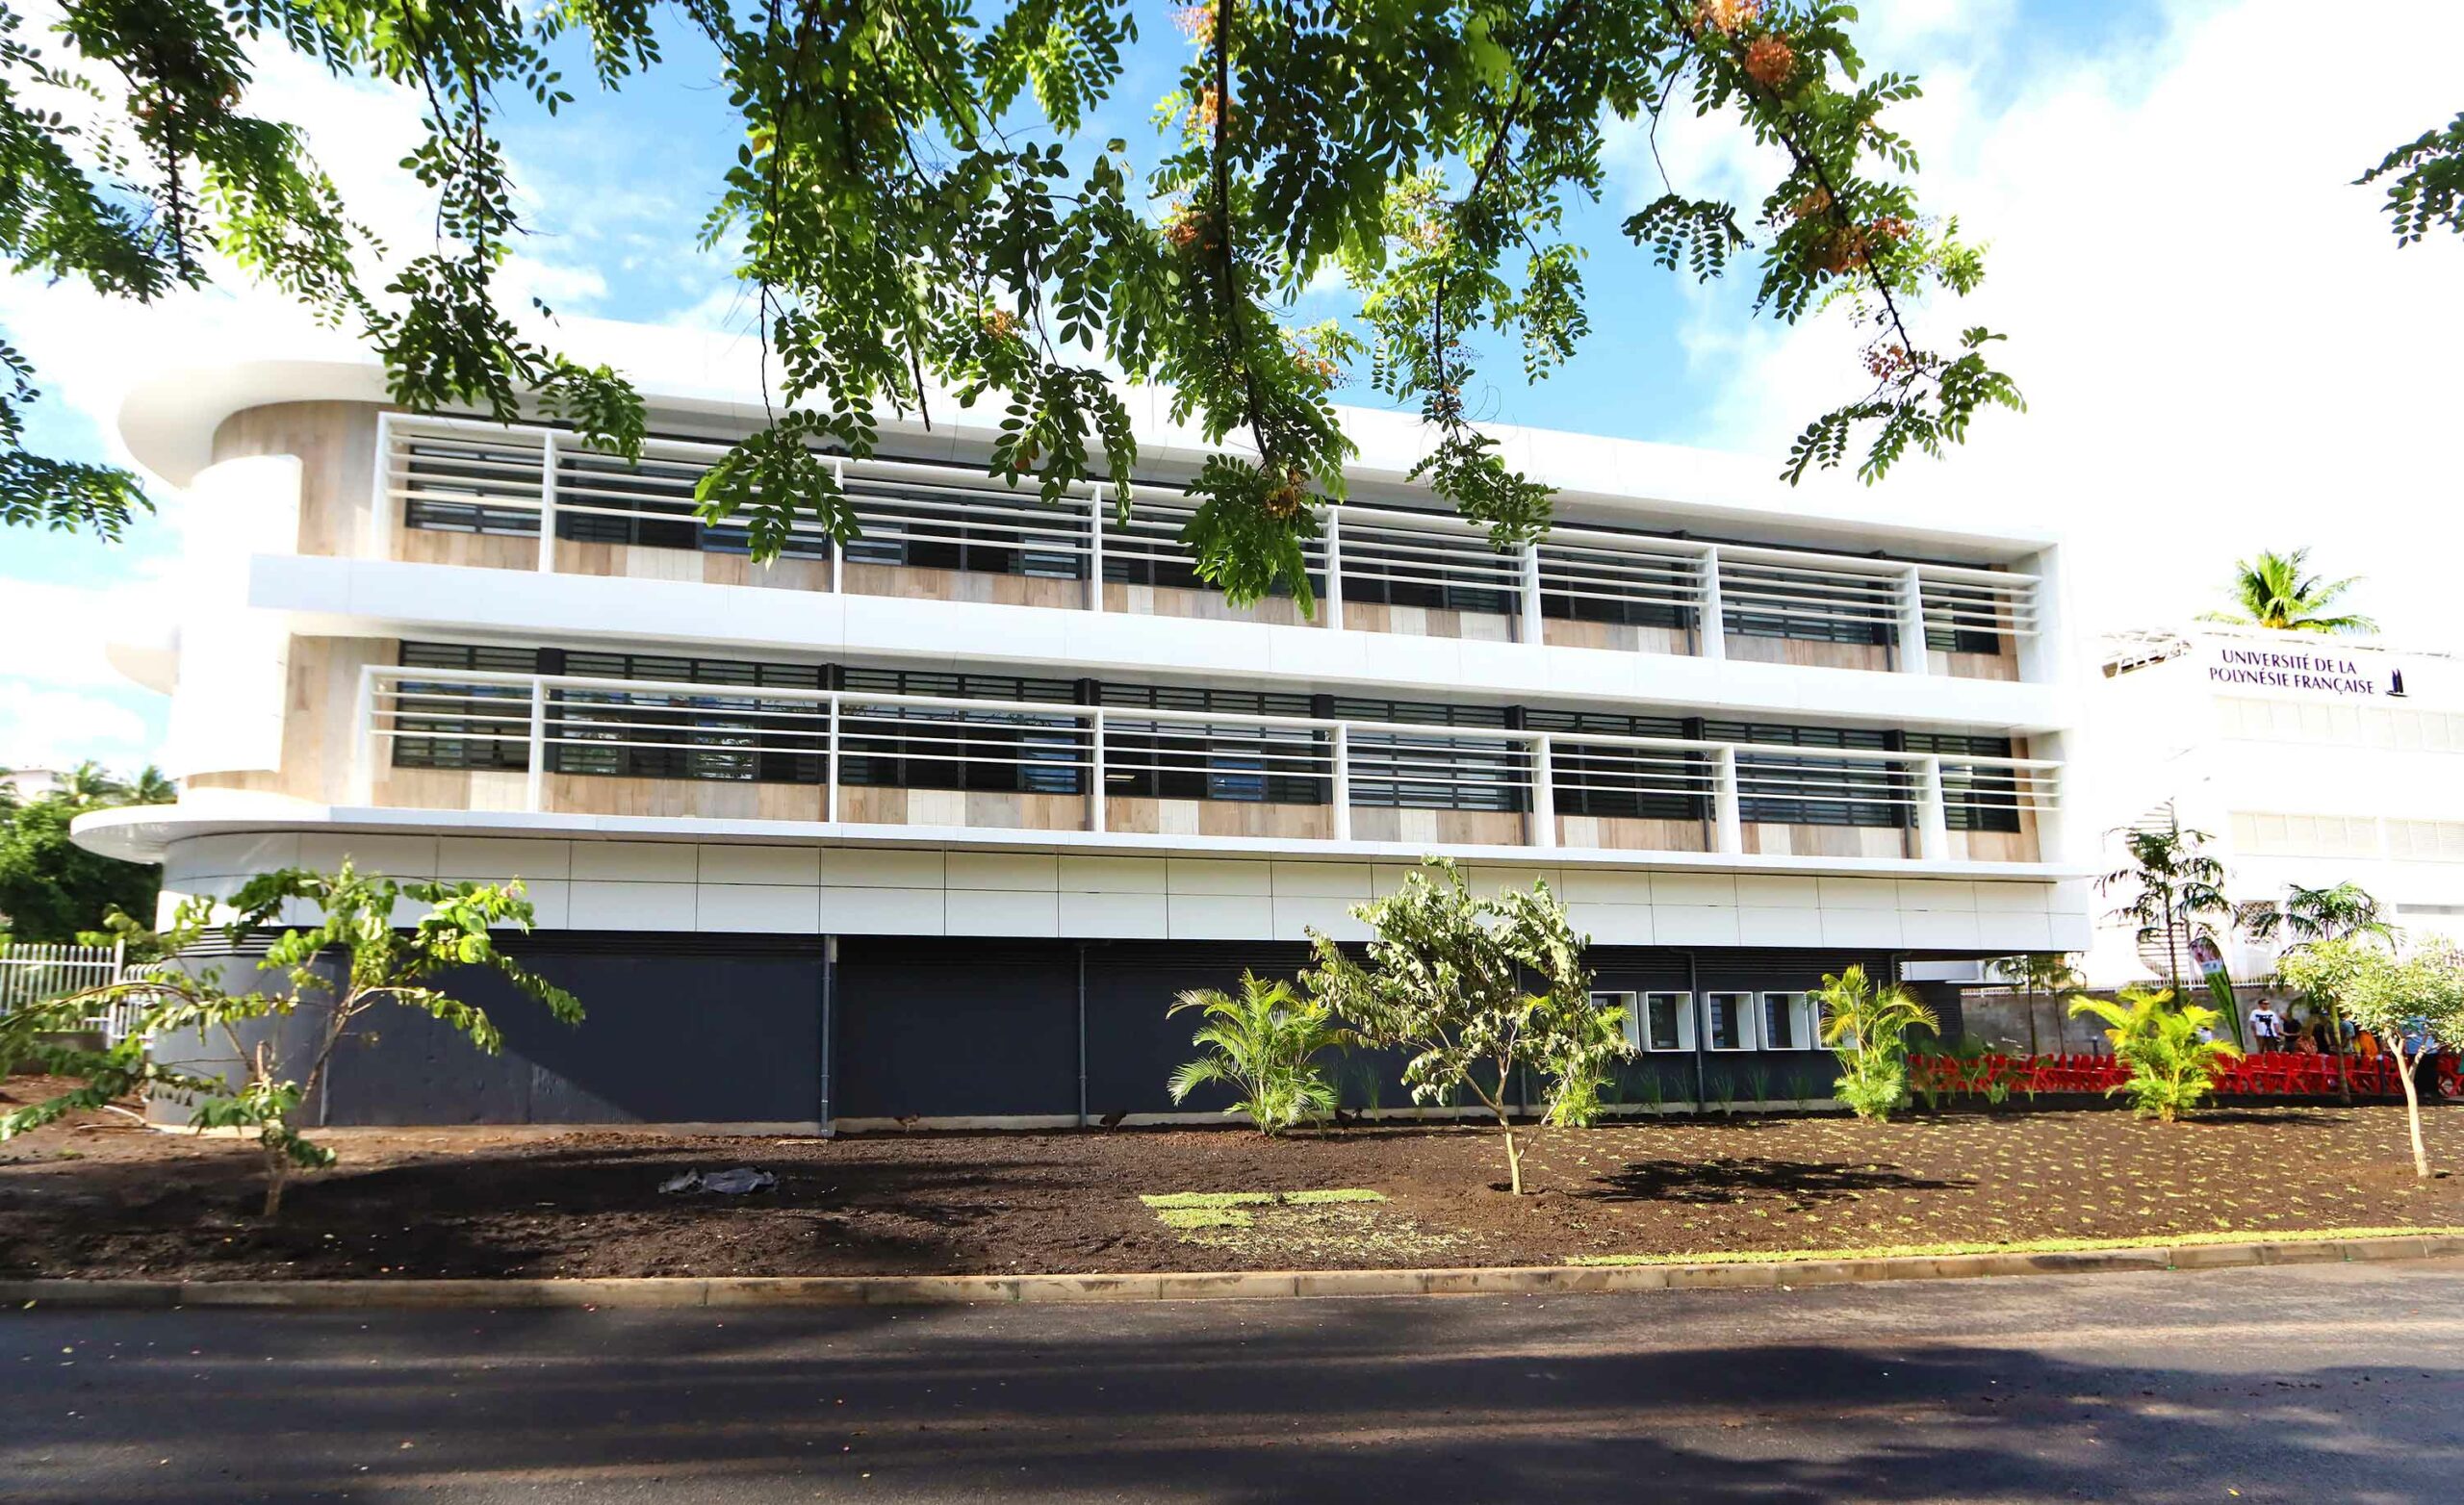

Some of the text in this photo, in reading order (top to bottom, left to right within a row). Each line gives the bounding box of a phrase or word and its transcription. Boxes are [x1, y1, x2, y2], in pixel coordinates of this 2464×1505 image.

[2221, 649, 2357, 675] UNIVERSITÉ DE LA
[2209, 667, 2374, 695] POLYNÉSIE FRANÇAISE
